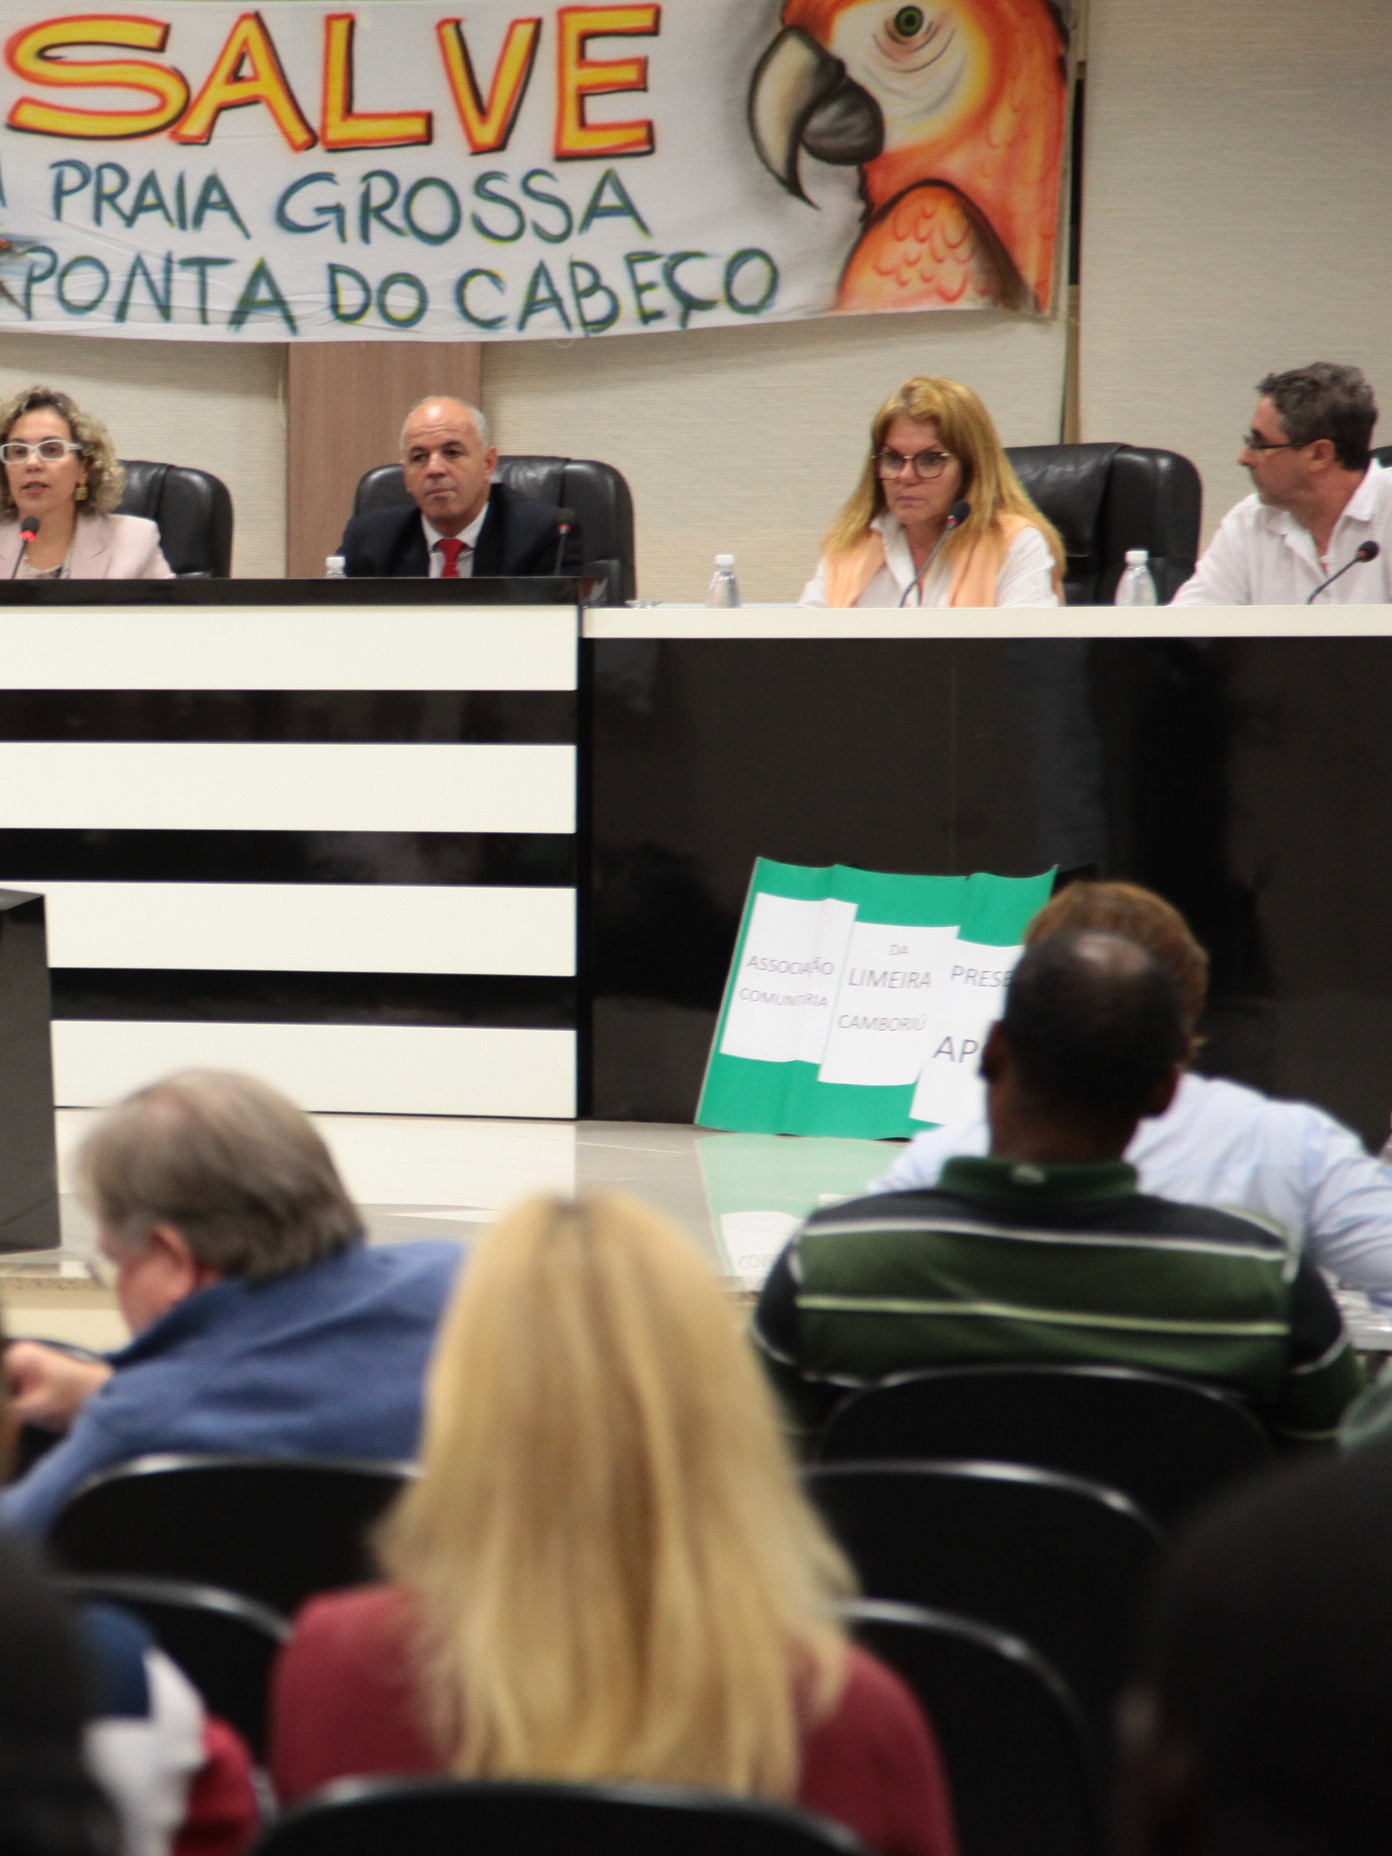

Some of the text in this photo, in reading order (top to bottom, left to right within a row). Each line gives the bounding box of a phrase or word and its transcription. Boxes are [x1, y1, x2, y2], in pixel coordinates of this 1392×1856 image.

[5, 3, 661, 161] SALVE
[49, 160, 252, 239] PRAIA
[276, 167, 653, 245] GROSSA
[21, 245, 780, 336] PONTA DO CABEÇO
[888, 943, 909, 957] DA
[848, 967, 932, 989] LIMEIRA
[837, 1014, 928, 1032] CAMBORIÚ
